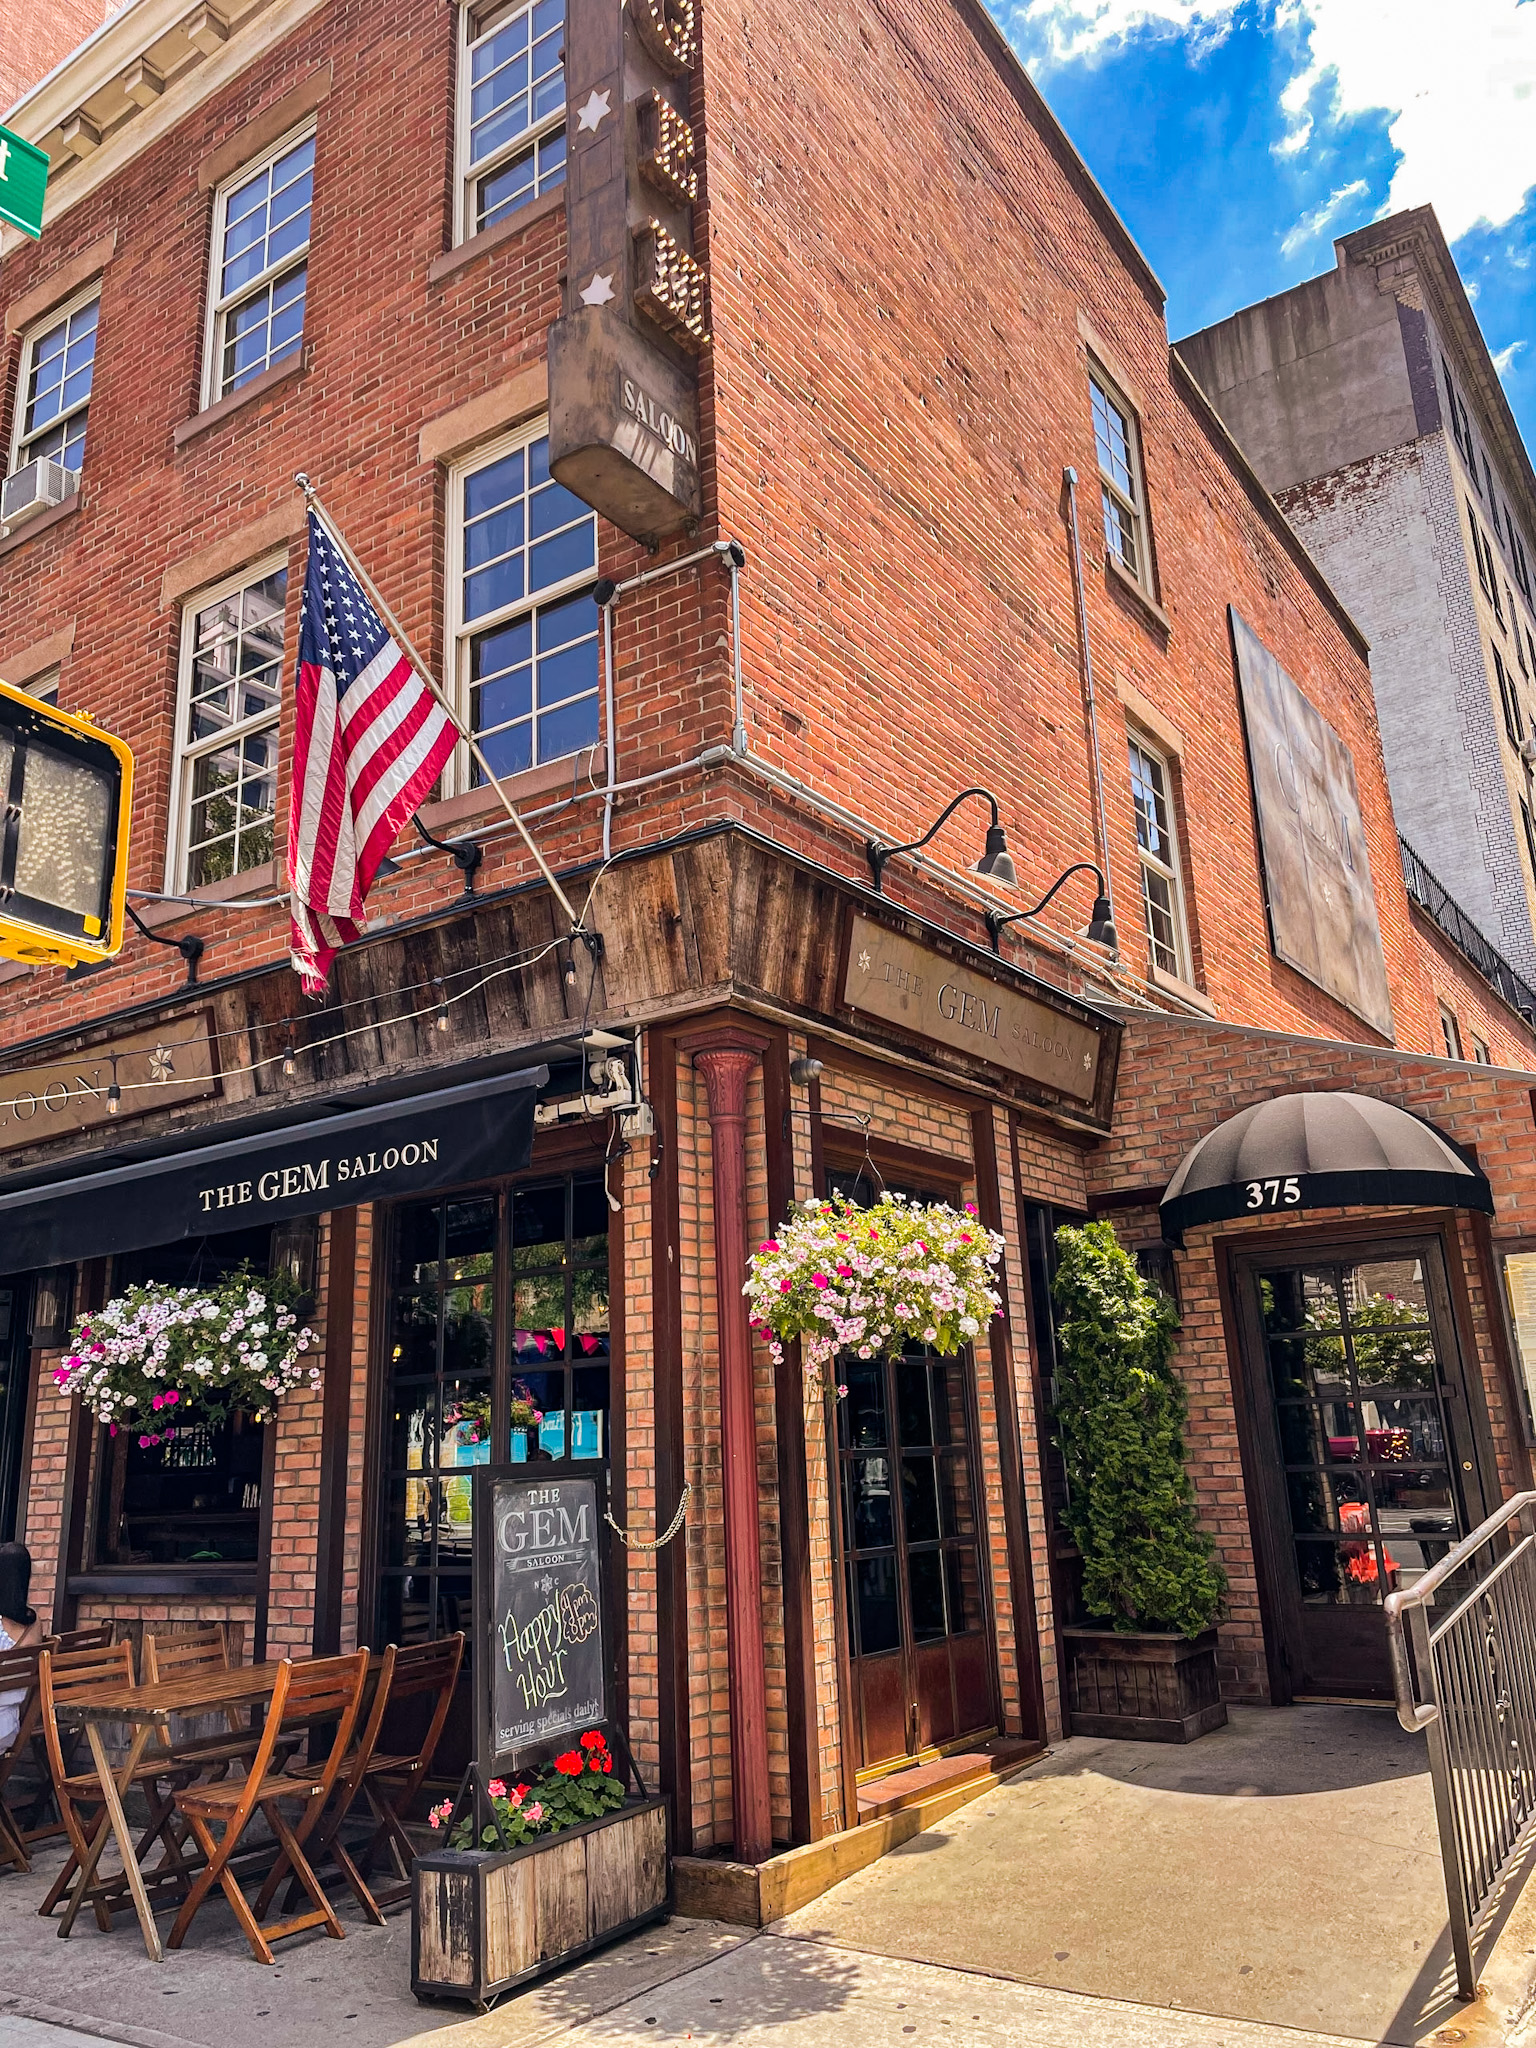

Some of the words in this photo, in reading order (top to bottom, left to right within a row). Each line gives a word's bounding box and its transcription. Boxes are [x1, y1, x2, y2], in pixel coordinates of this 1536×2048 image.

[623, 379, 698, 467] SALOON
[882, 961, 924, 998] THE
[936, 982, 1001, 1040] GEM
[1010, 1022, 1075, 1063] SALOON
[0, 1069, 101, 1126] OON
[199, 1181, 253, 1212] THE
[257, 1159, 331, 1202] GEM
[336, 1138, 440, 1182] SALOON
[1245, 1177, 1301, 1209] 375
[526, 1487, 561, 1506] THE
[497, 1504, 591, 1553] GEM
[526, 1553, 566, 1568] SALOON
[498, 1588, 562, 1672] Happy
[561, 1592, 589, 1618] 4pm
[516, 1649, 568, 1711] Hour
[499, 1719, 535, 1740] serving
[536, 1706, 572, 1734] specials
